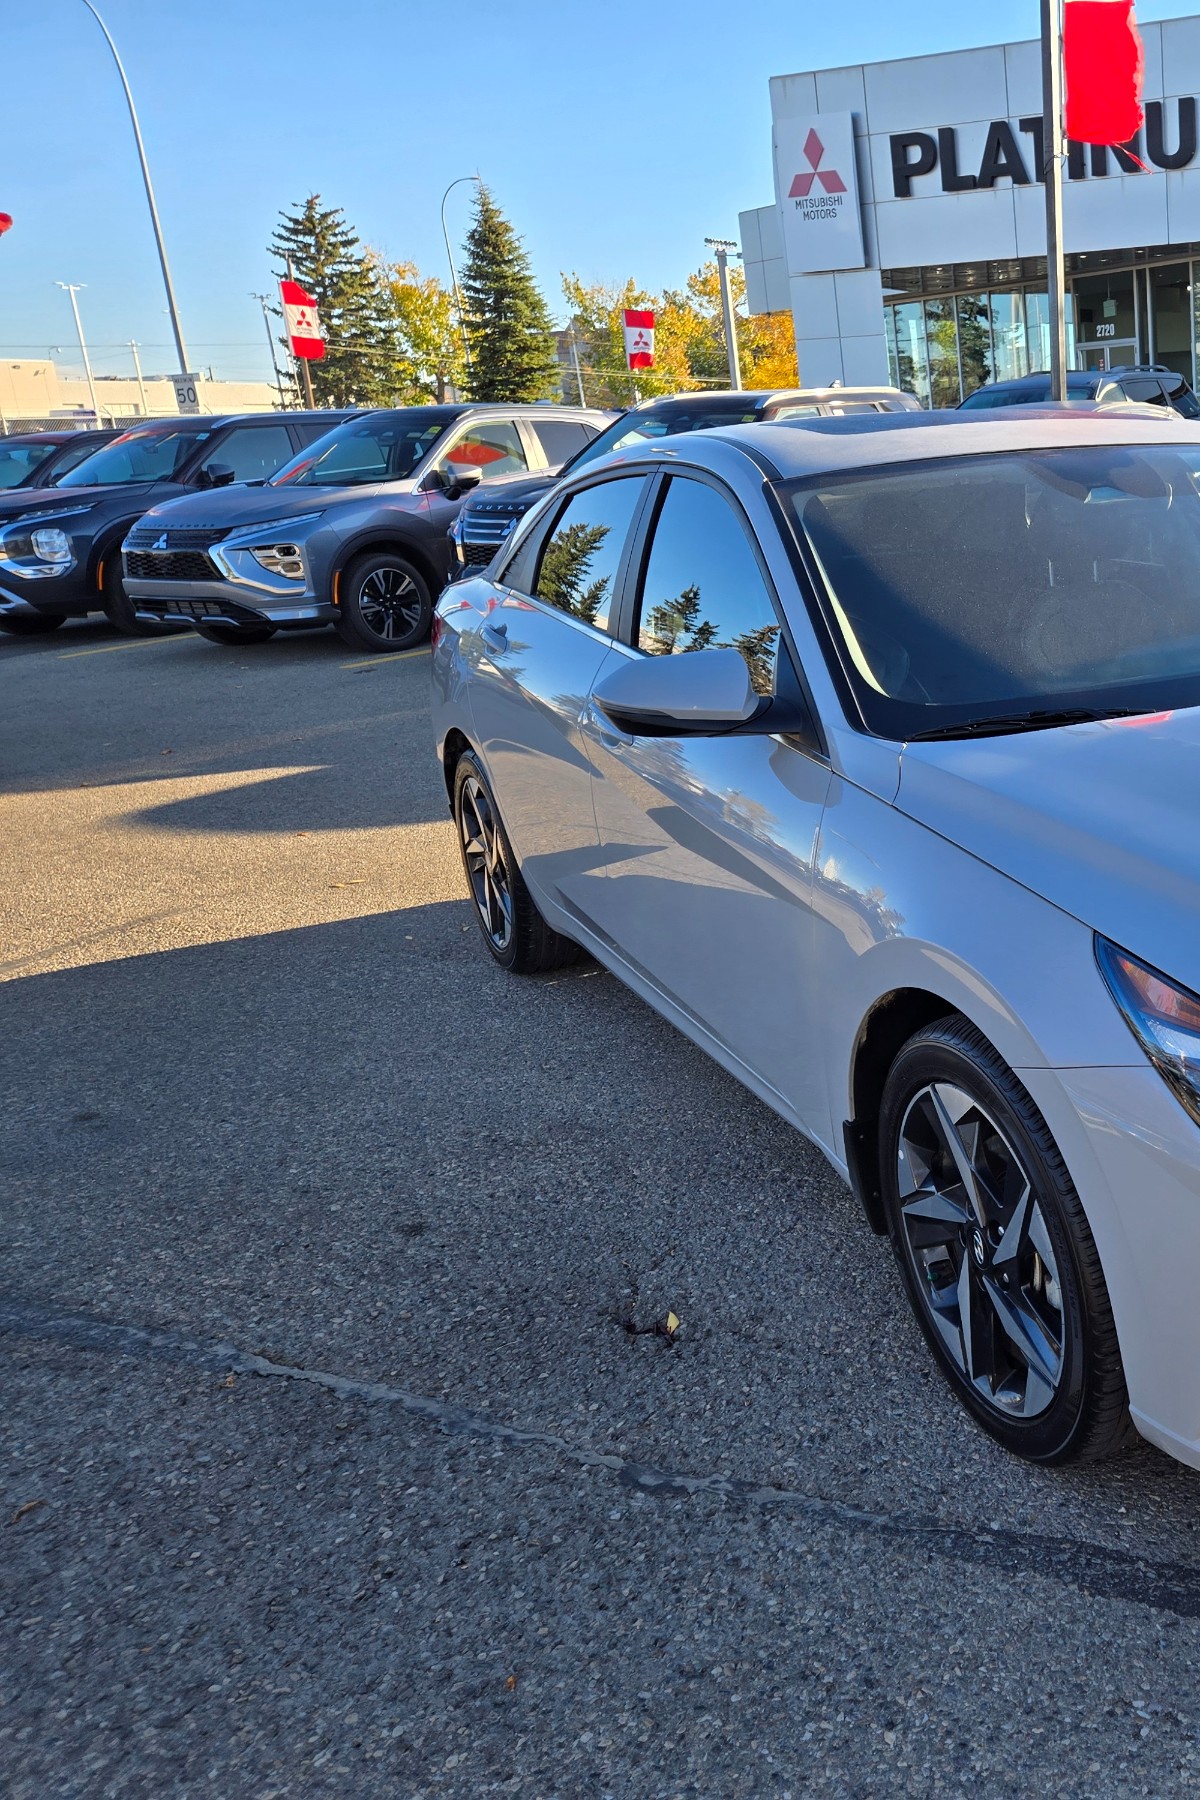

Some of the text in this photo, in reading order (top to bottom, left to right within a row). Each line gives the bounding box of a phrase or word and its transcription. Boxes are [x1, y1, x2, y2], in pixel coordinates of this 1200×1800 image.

[795, 195, 843, 210] MITSUBISHI
[803, 208, 837, 221] MOTORS
[1096, 323, 1115, 338] 2720
[177, 387, 196, 404] 50
